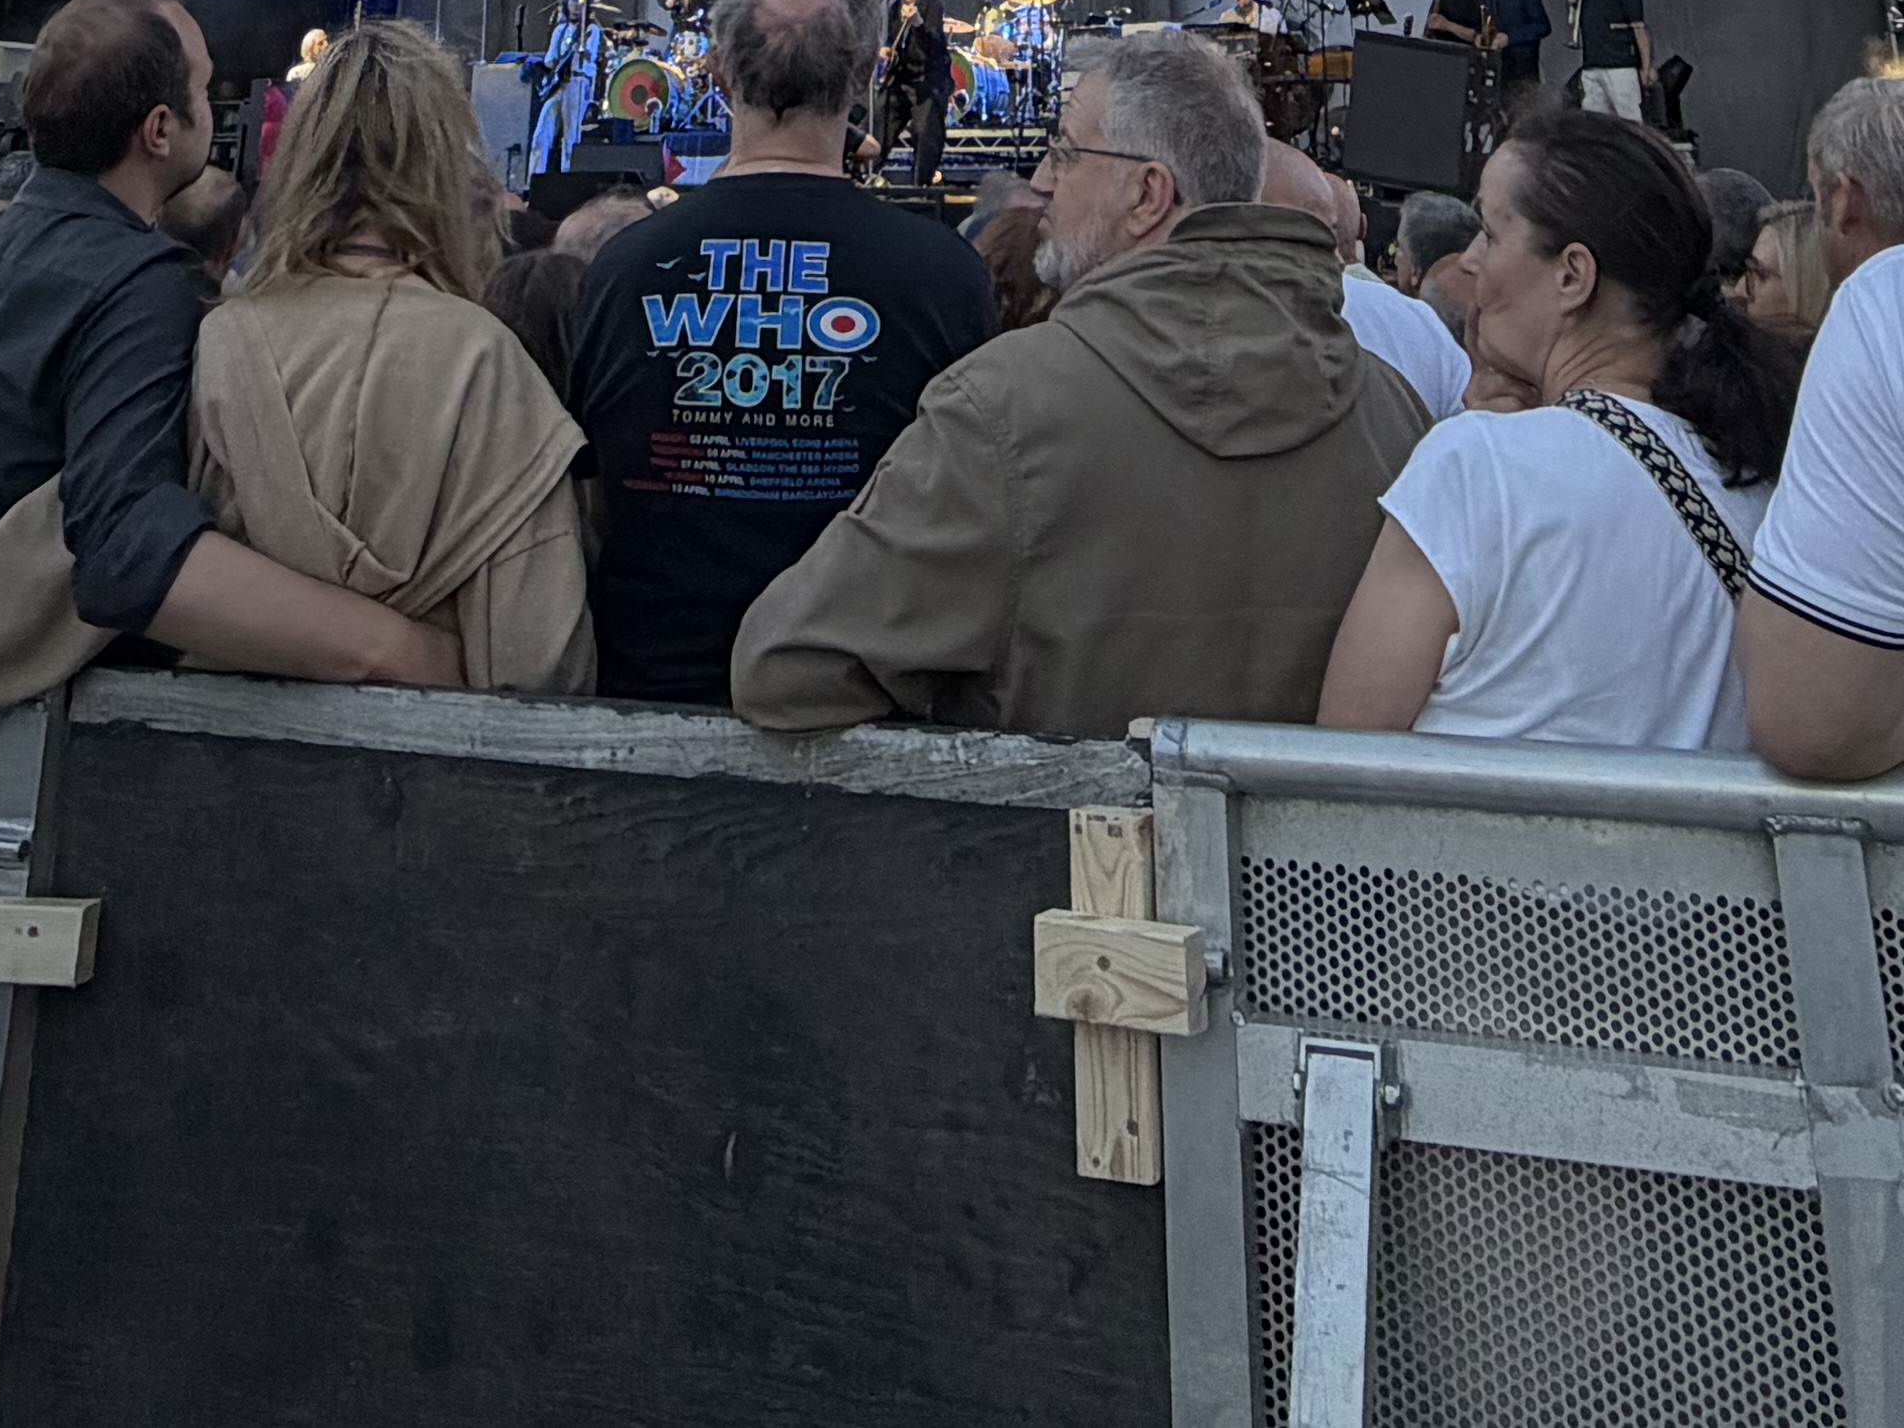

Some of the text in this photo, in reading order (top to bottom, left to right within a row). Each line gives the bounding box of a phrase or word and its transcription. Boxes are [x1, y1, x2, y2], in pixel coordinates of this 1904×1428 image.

[700, 239, 831, 294] THE
[642, 293, 881, 353] WHO
[673, 351, 853, 411] 2017
[671, 409, 835, 428] TOMMY AND MORE
